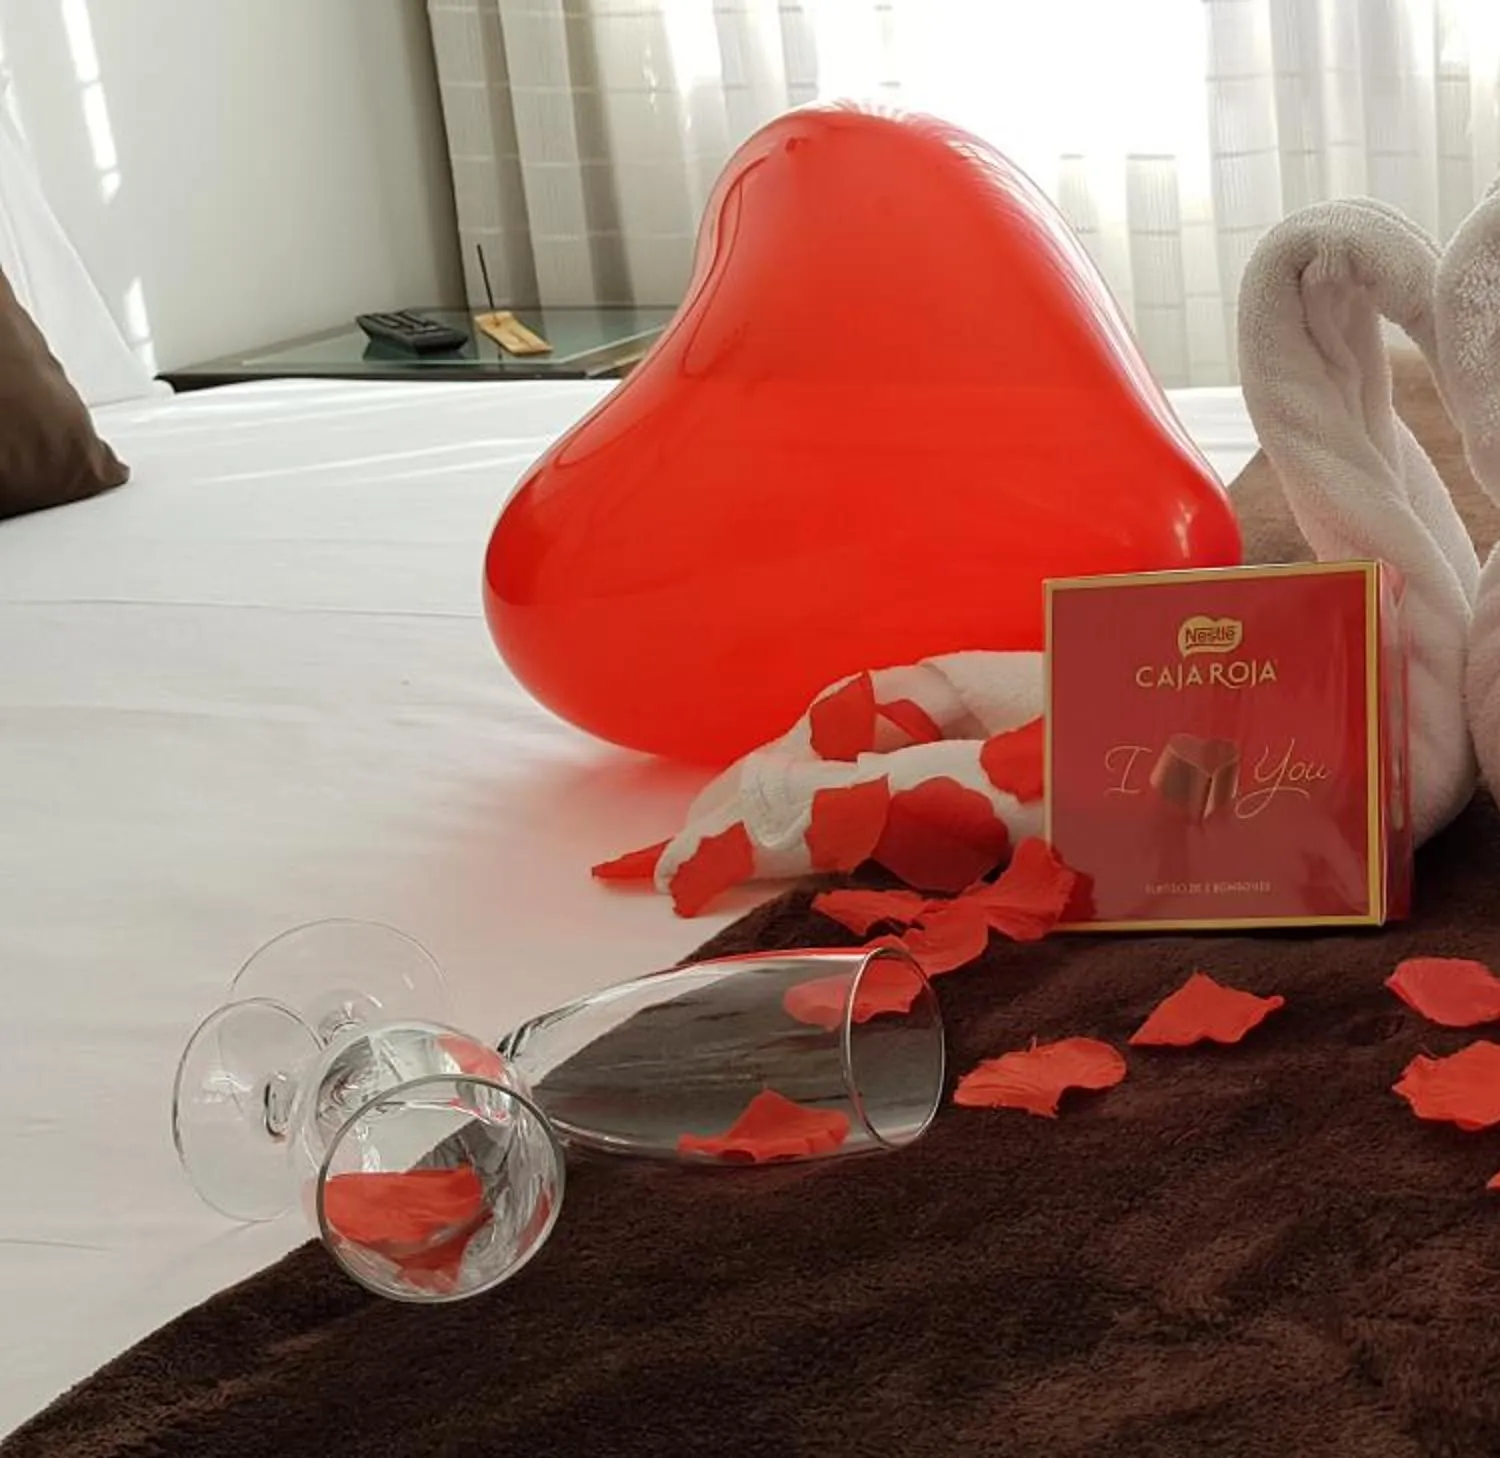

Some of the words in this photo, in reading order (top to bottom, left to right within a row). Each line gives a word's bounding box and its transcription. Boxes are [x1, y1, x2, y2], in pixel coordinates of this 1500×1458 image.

[1135, 663, 1203, 692] CAJA
[1209, 659, 1277, 689] ROJA
[1104, 745, 1153, 795] I
[1235, 737, 1332, 819] You
